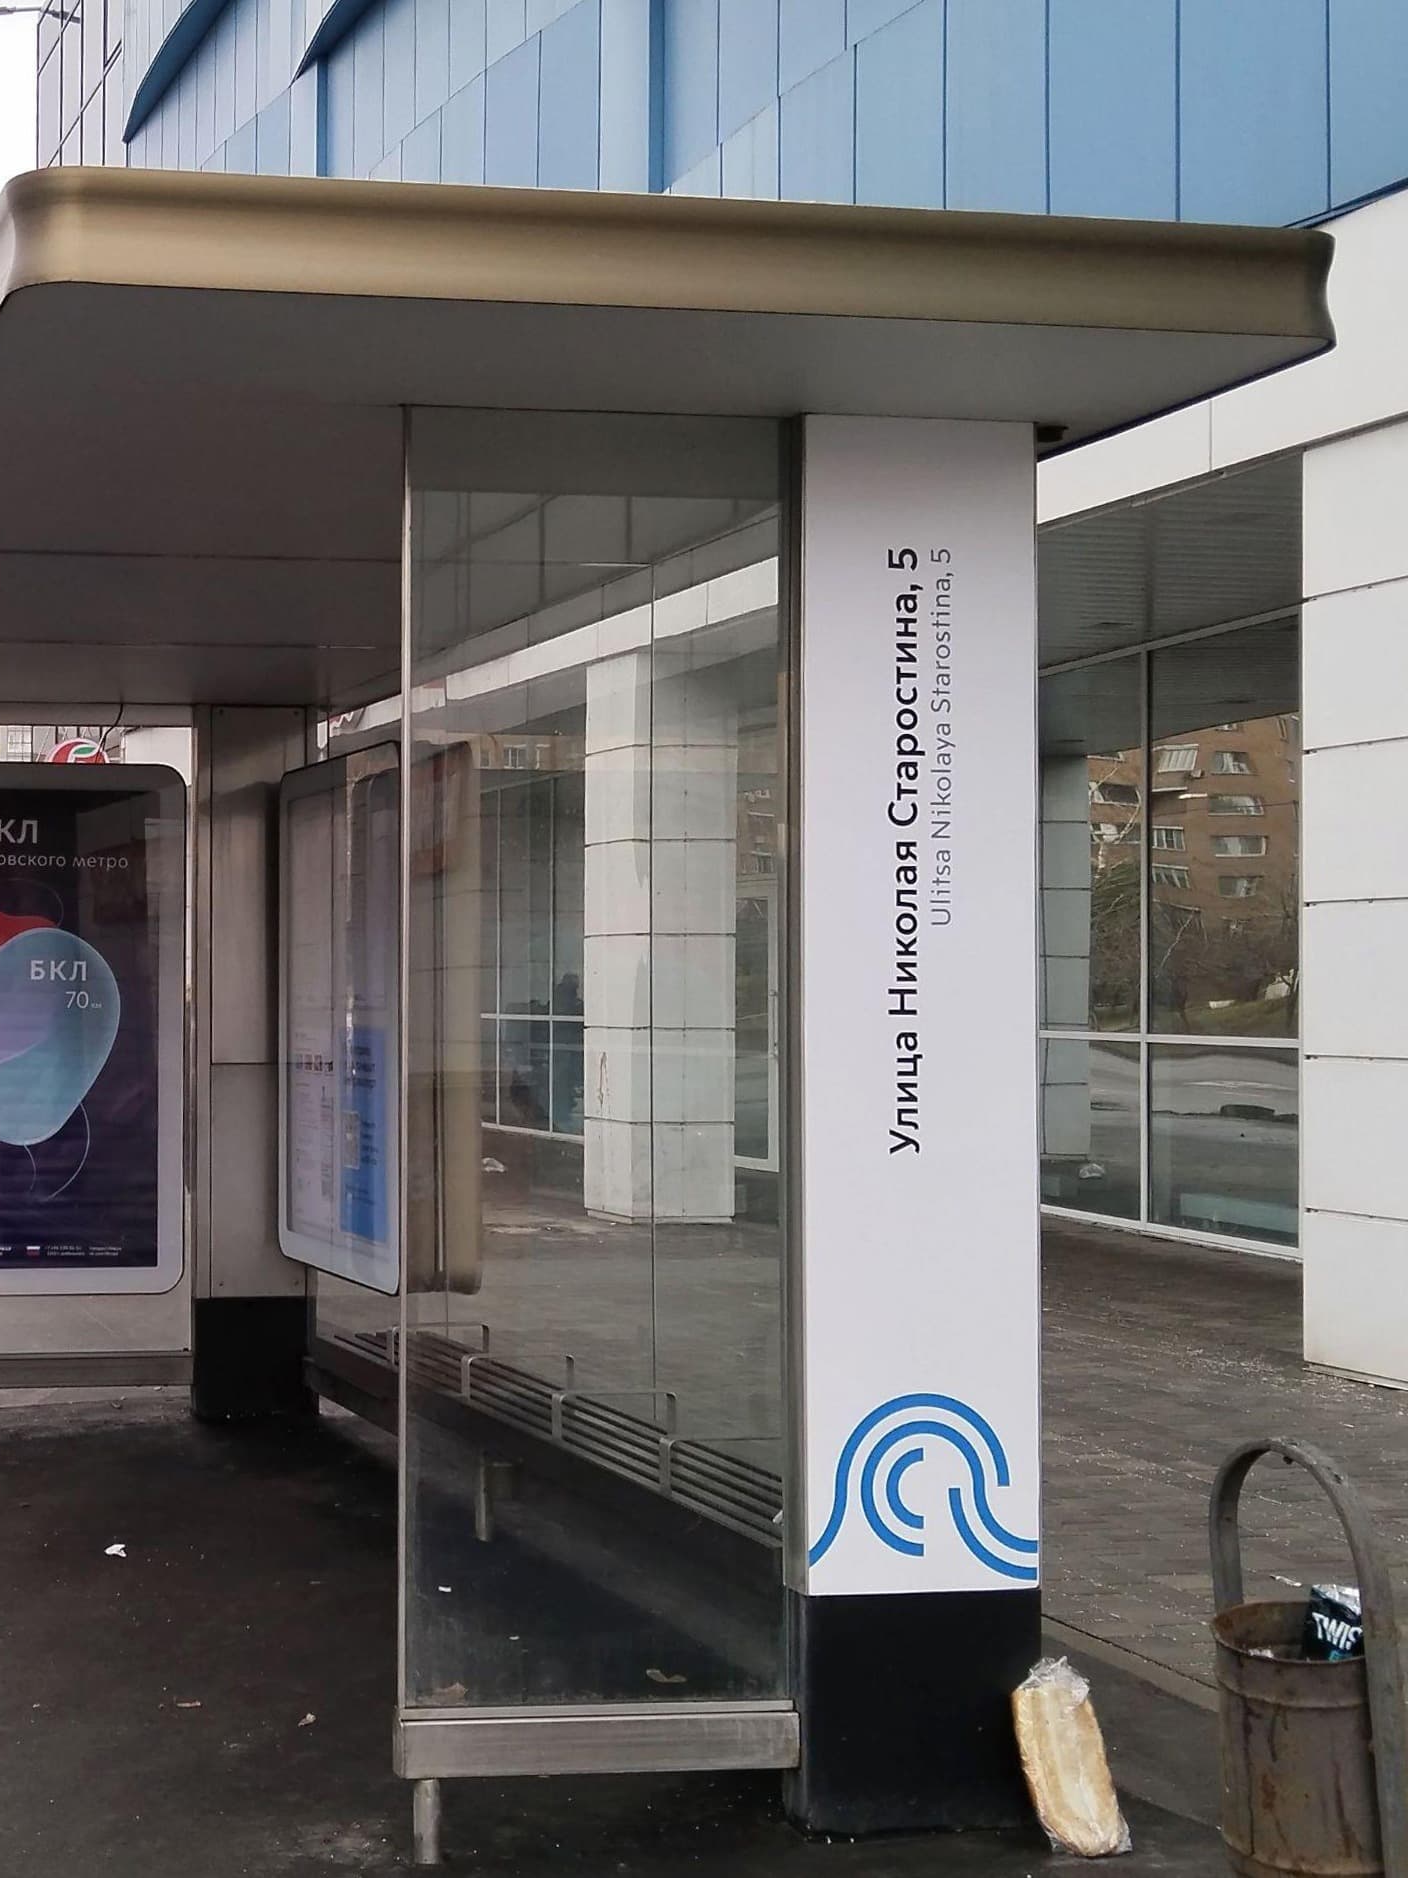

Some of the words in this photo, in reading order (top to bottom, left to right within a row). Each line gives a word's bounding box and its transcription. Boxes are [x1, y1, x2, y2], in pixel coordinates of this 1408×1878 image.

[888, 548, 918, 572] 5
[930, 548, 952, 564] 5
[930, 572, 954, 714] Starostina,
[888, 583, 926, 827] Старостина,
[930, 723, 956, 839] Nikolaya
[72, 856, 129, 872] метро
[930, 850, 952, 926] Ulitsa
[888, 842, 918, 1016] Николая
[30, 960, 88, 982] БКЛ
[65, 991, 89, 1009] 70
[889, 1032, 924, 1155] Улица
